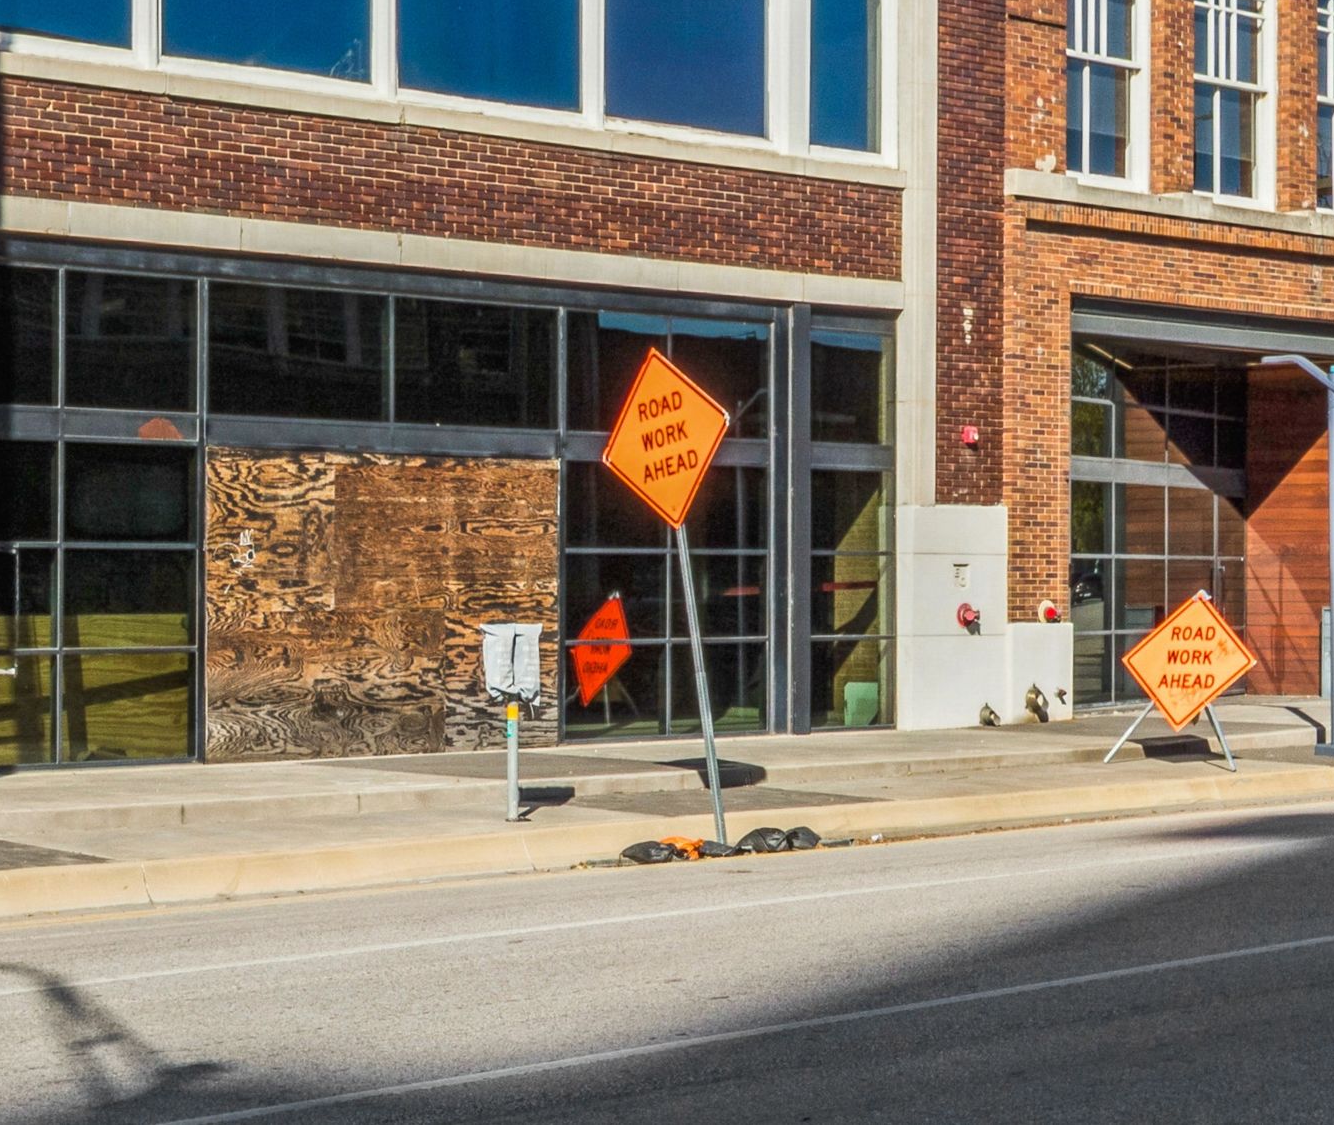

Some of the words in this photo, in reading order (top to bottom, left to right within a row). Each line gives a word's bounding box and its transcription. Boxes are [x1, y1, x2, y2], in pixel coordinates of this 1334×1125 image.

[638, 391, 683, 422] ROAD
[642, 420, 689, 452] WORK
[644, 449, 699, 484] AHEAD
[1171, 626, 1216, 641] ROAD
[1167, 650, 1213, 665] WORK
[1158, 674, 1215, 689] AHEAD
